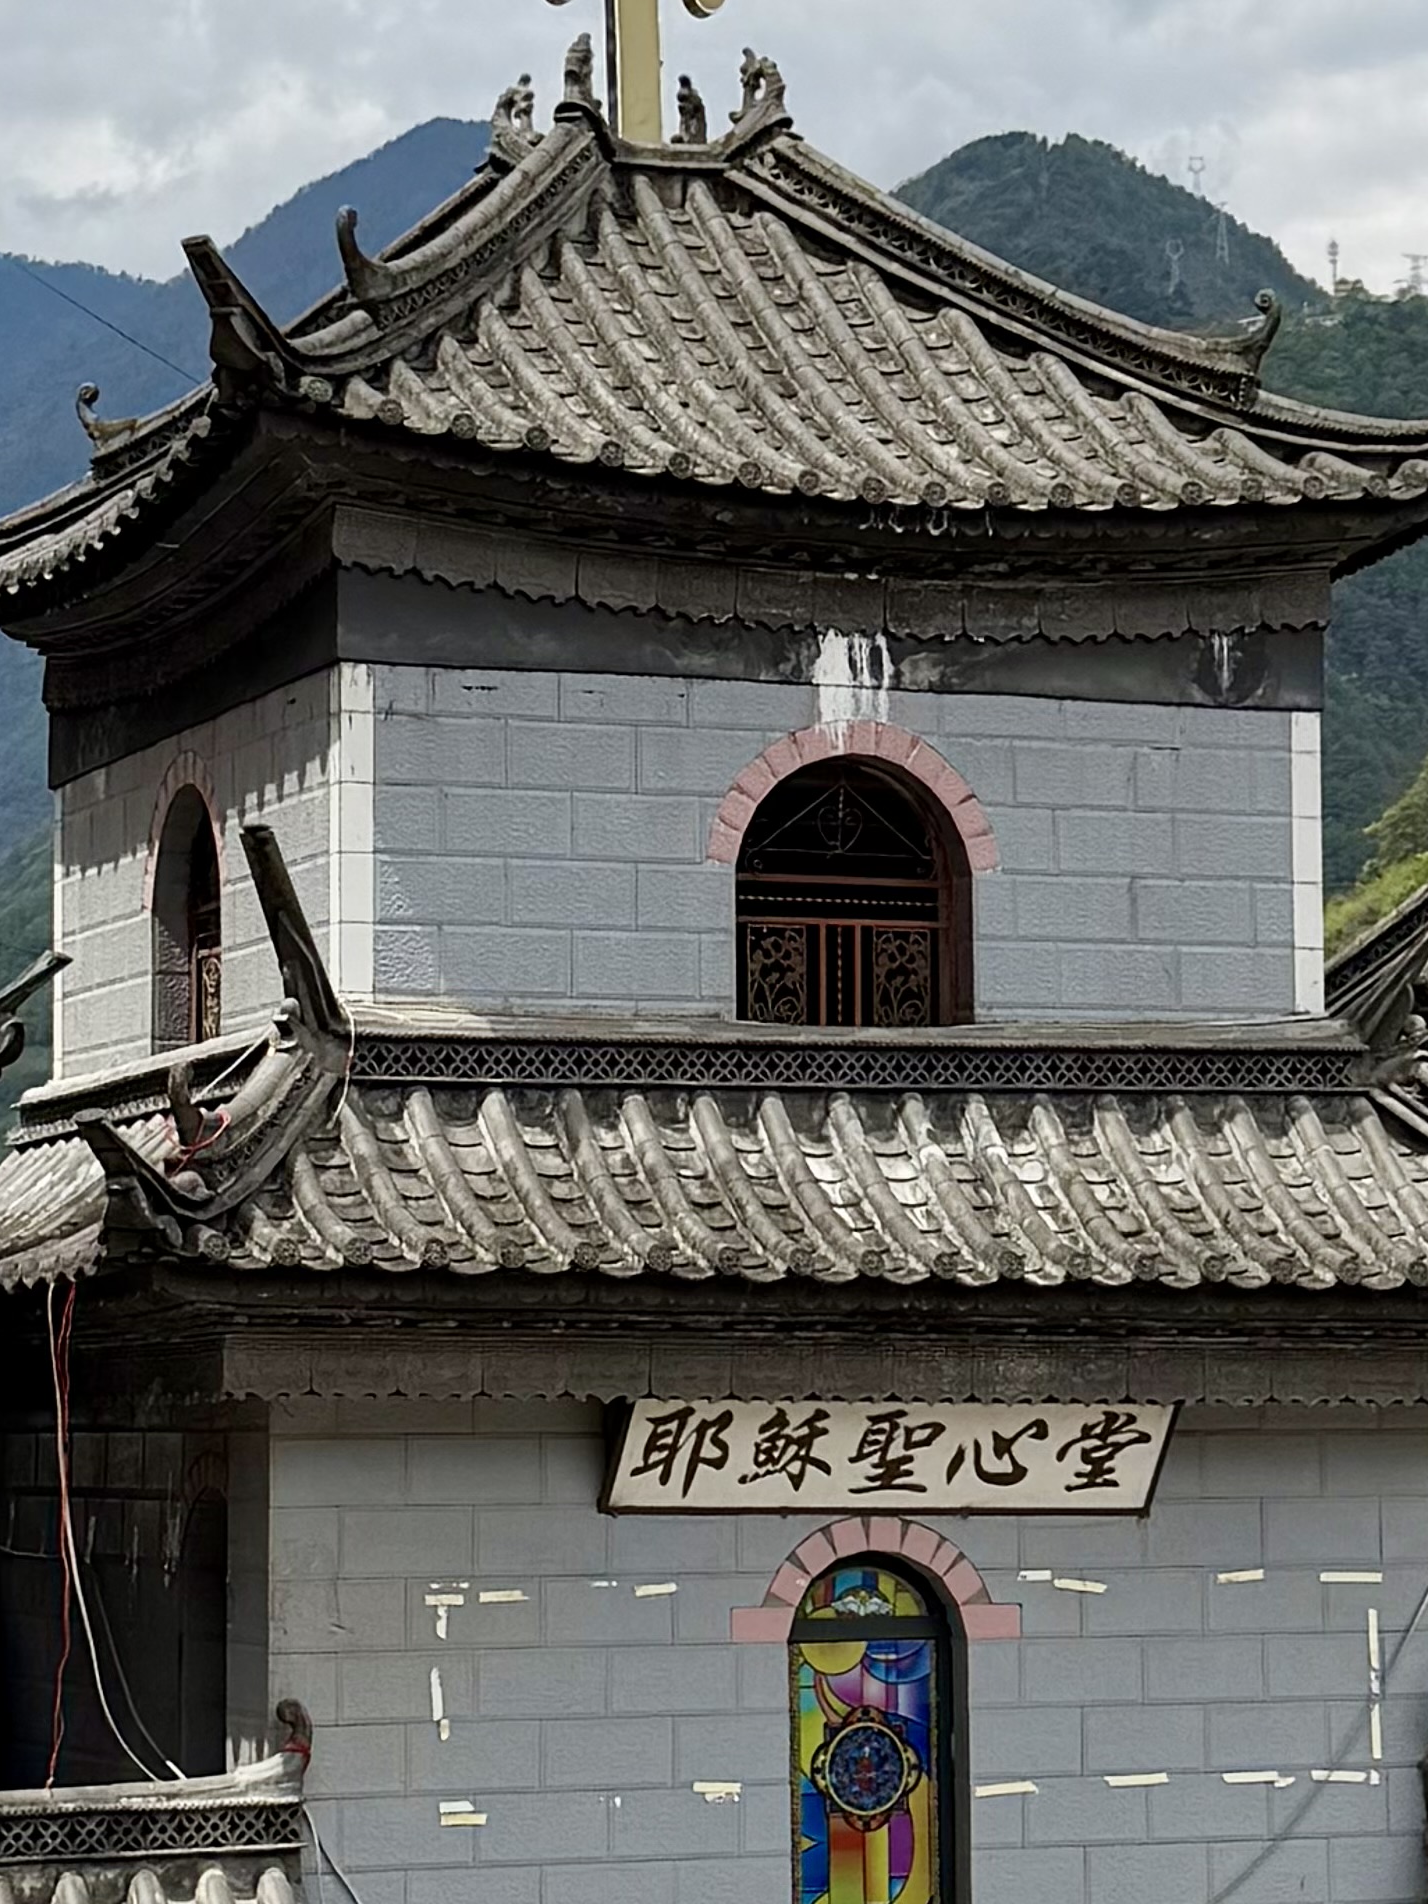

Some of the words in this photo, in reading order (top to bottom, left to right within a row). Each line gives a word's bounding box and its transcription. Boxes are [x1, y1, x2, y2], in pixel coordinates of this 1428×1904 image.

[629, 1405, 1153, 1499] 耶穌聖心堂
